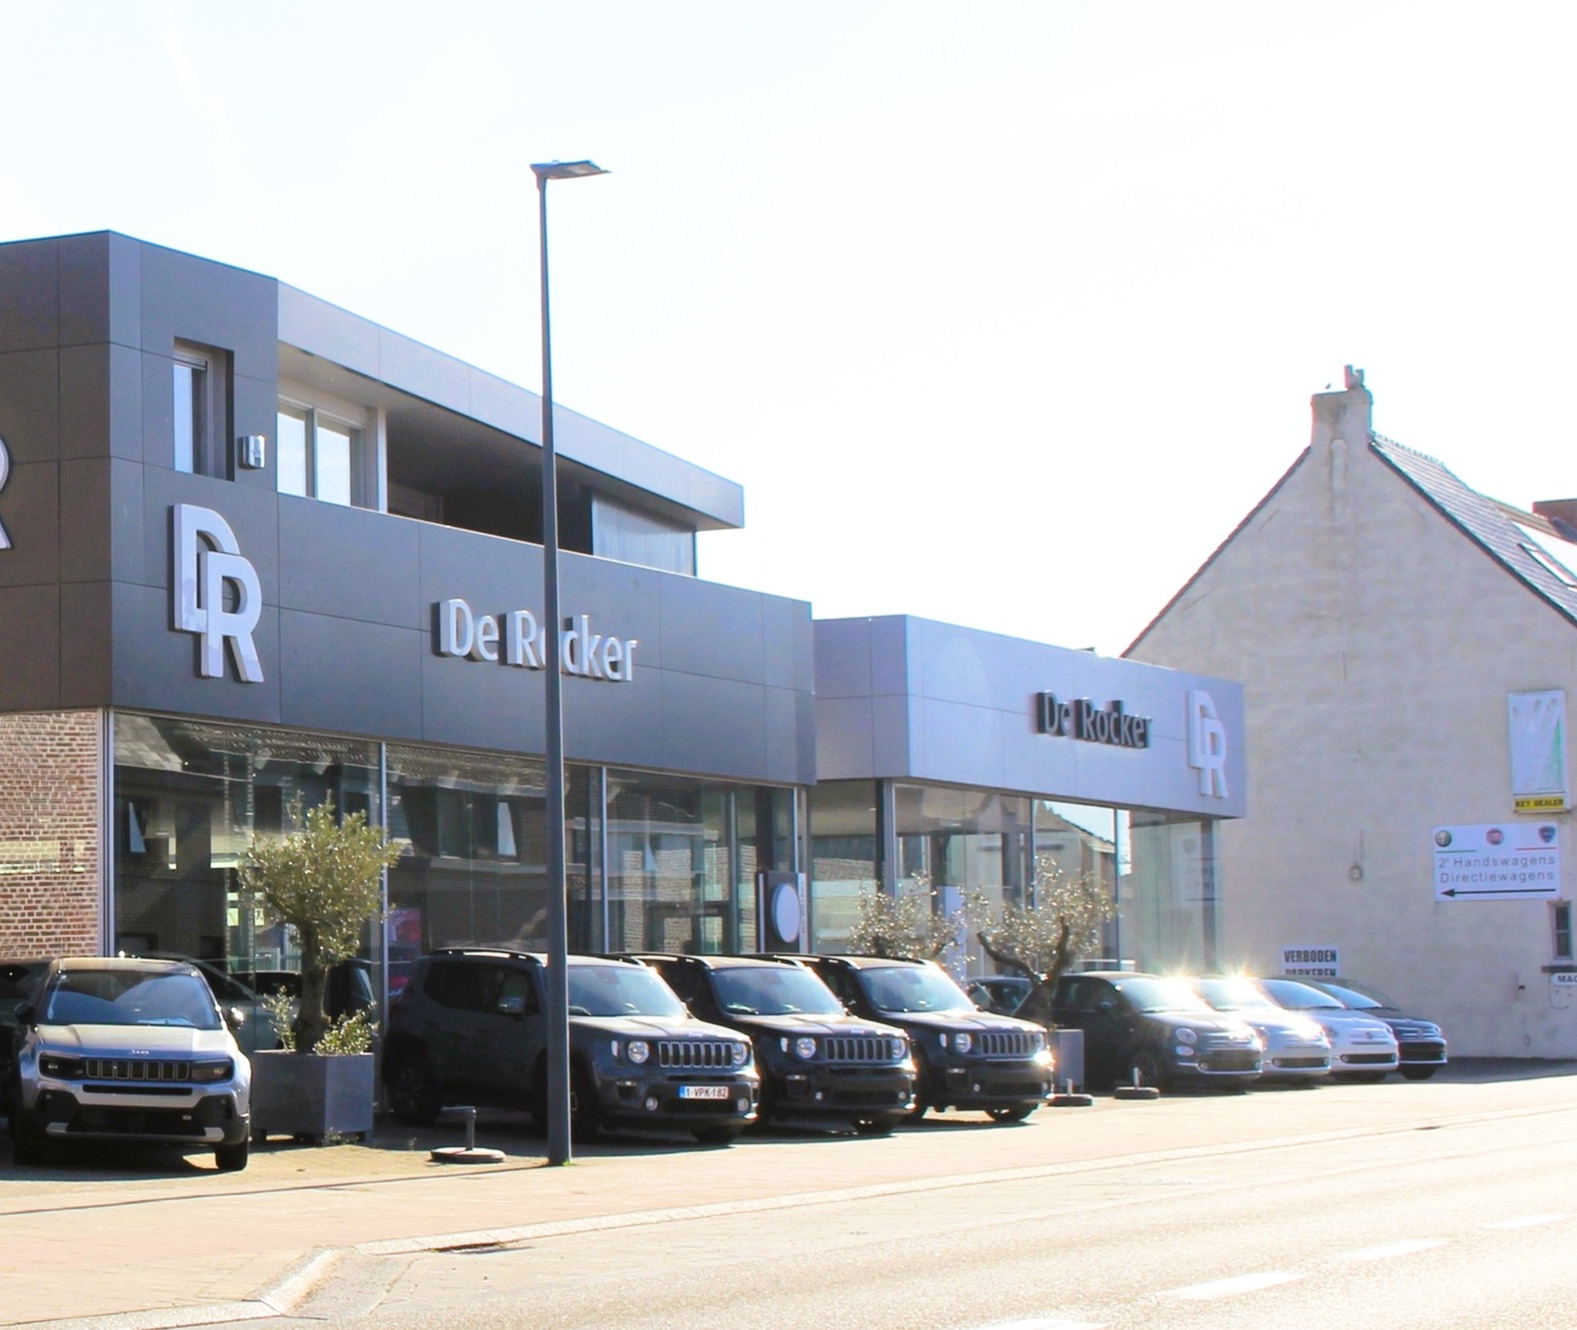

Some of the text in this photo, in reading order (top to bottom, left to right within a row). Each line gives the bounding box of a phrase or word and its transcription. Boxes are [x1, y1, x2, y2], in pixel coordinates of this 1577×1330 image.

[172, 503, 264, 683] DR
[436, 598, 638, 682] De Rcker
[1035, 689, 1153, 749] De Rocker
[1453, 855, 1556, 868] Handswagens
[1440, 871, 1554, 883] Directiewagens
[1284, 949, 1337, 963] VERBODEN
[686, 1087, 727, 1097] 1-VPK-182
